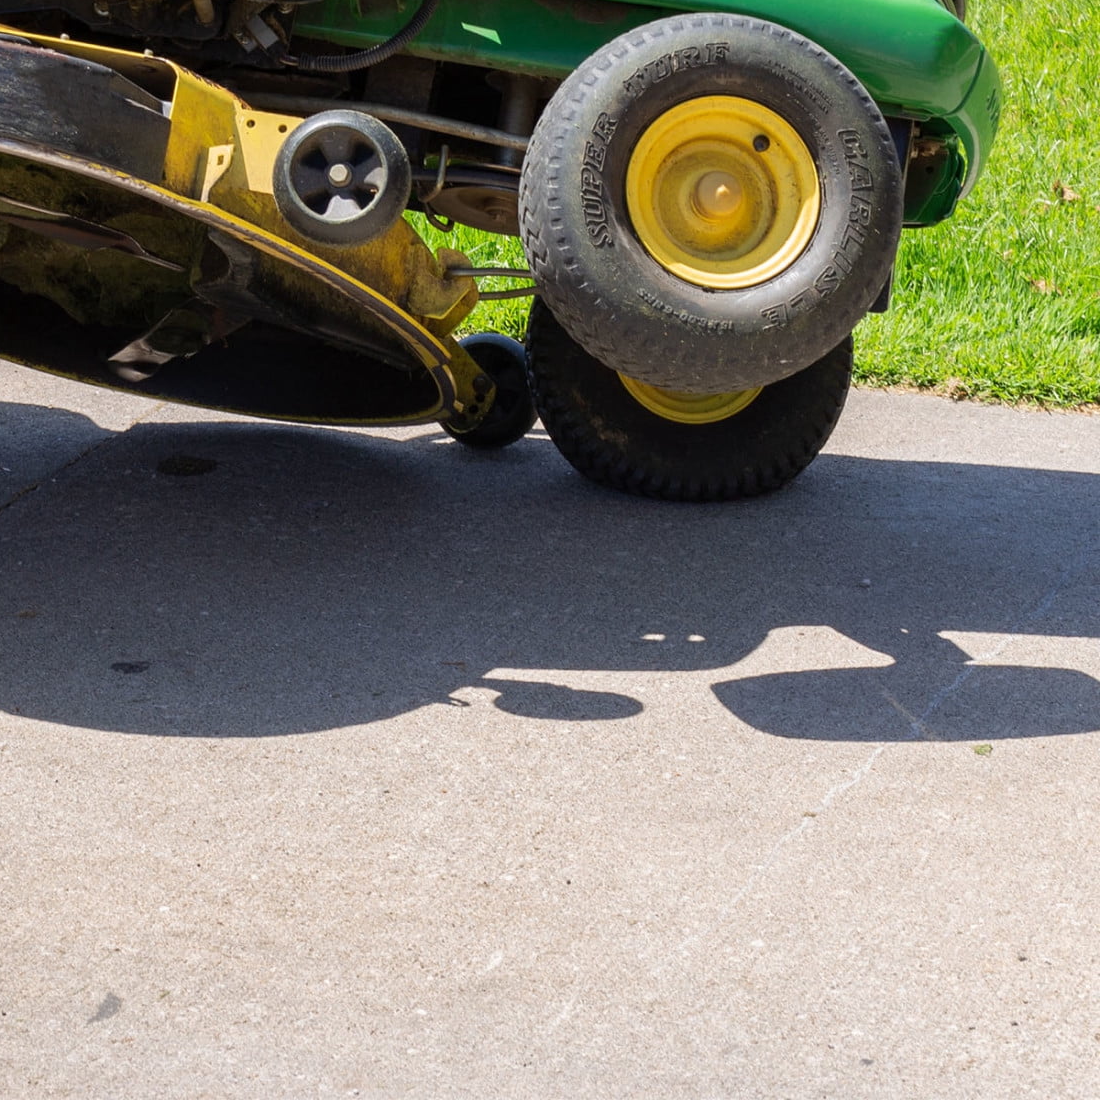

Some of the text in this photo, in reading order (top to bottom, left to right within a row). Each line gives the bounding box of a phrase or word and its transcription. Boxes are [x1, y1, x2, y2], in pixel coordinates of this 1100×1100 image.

[581, 41, 731, 249] SUPER TURF
[760, 128, 875, 332] CARLISLE
